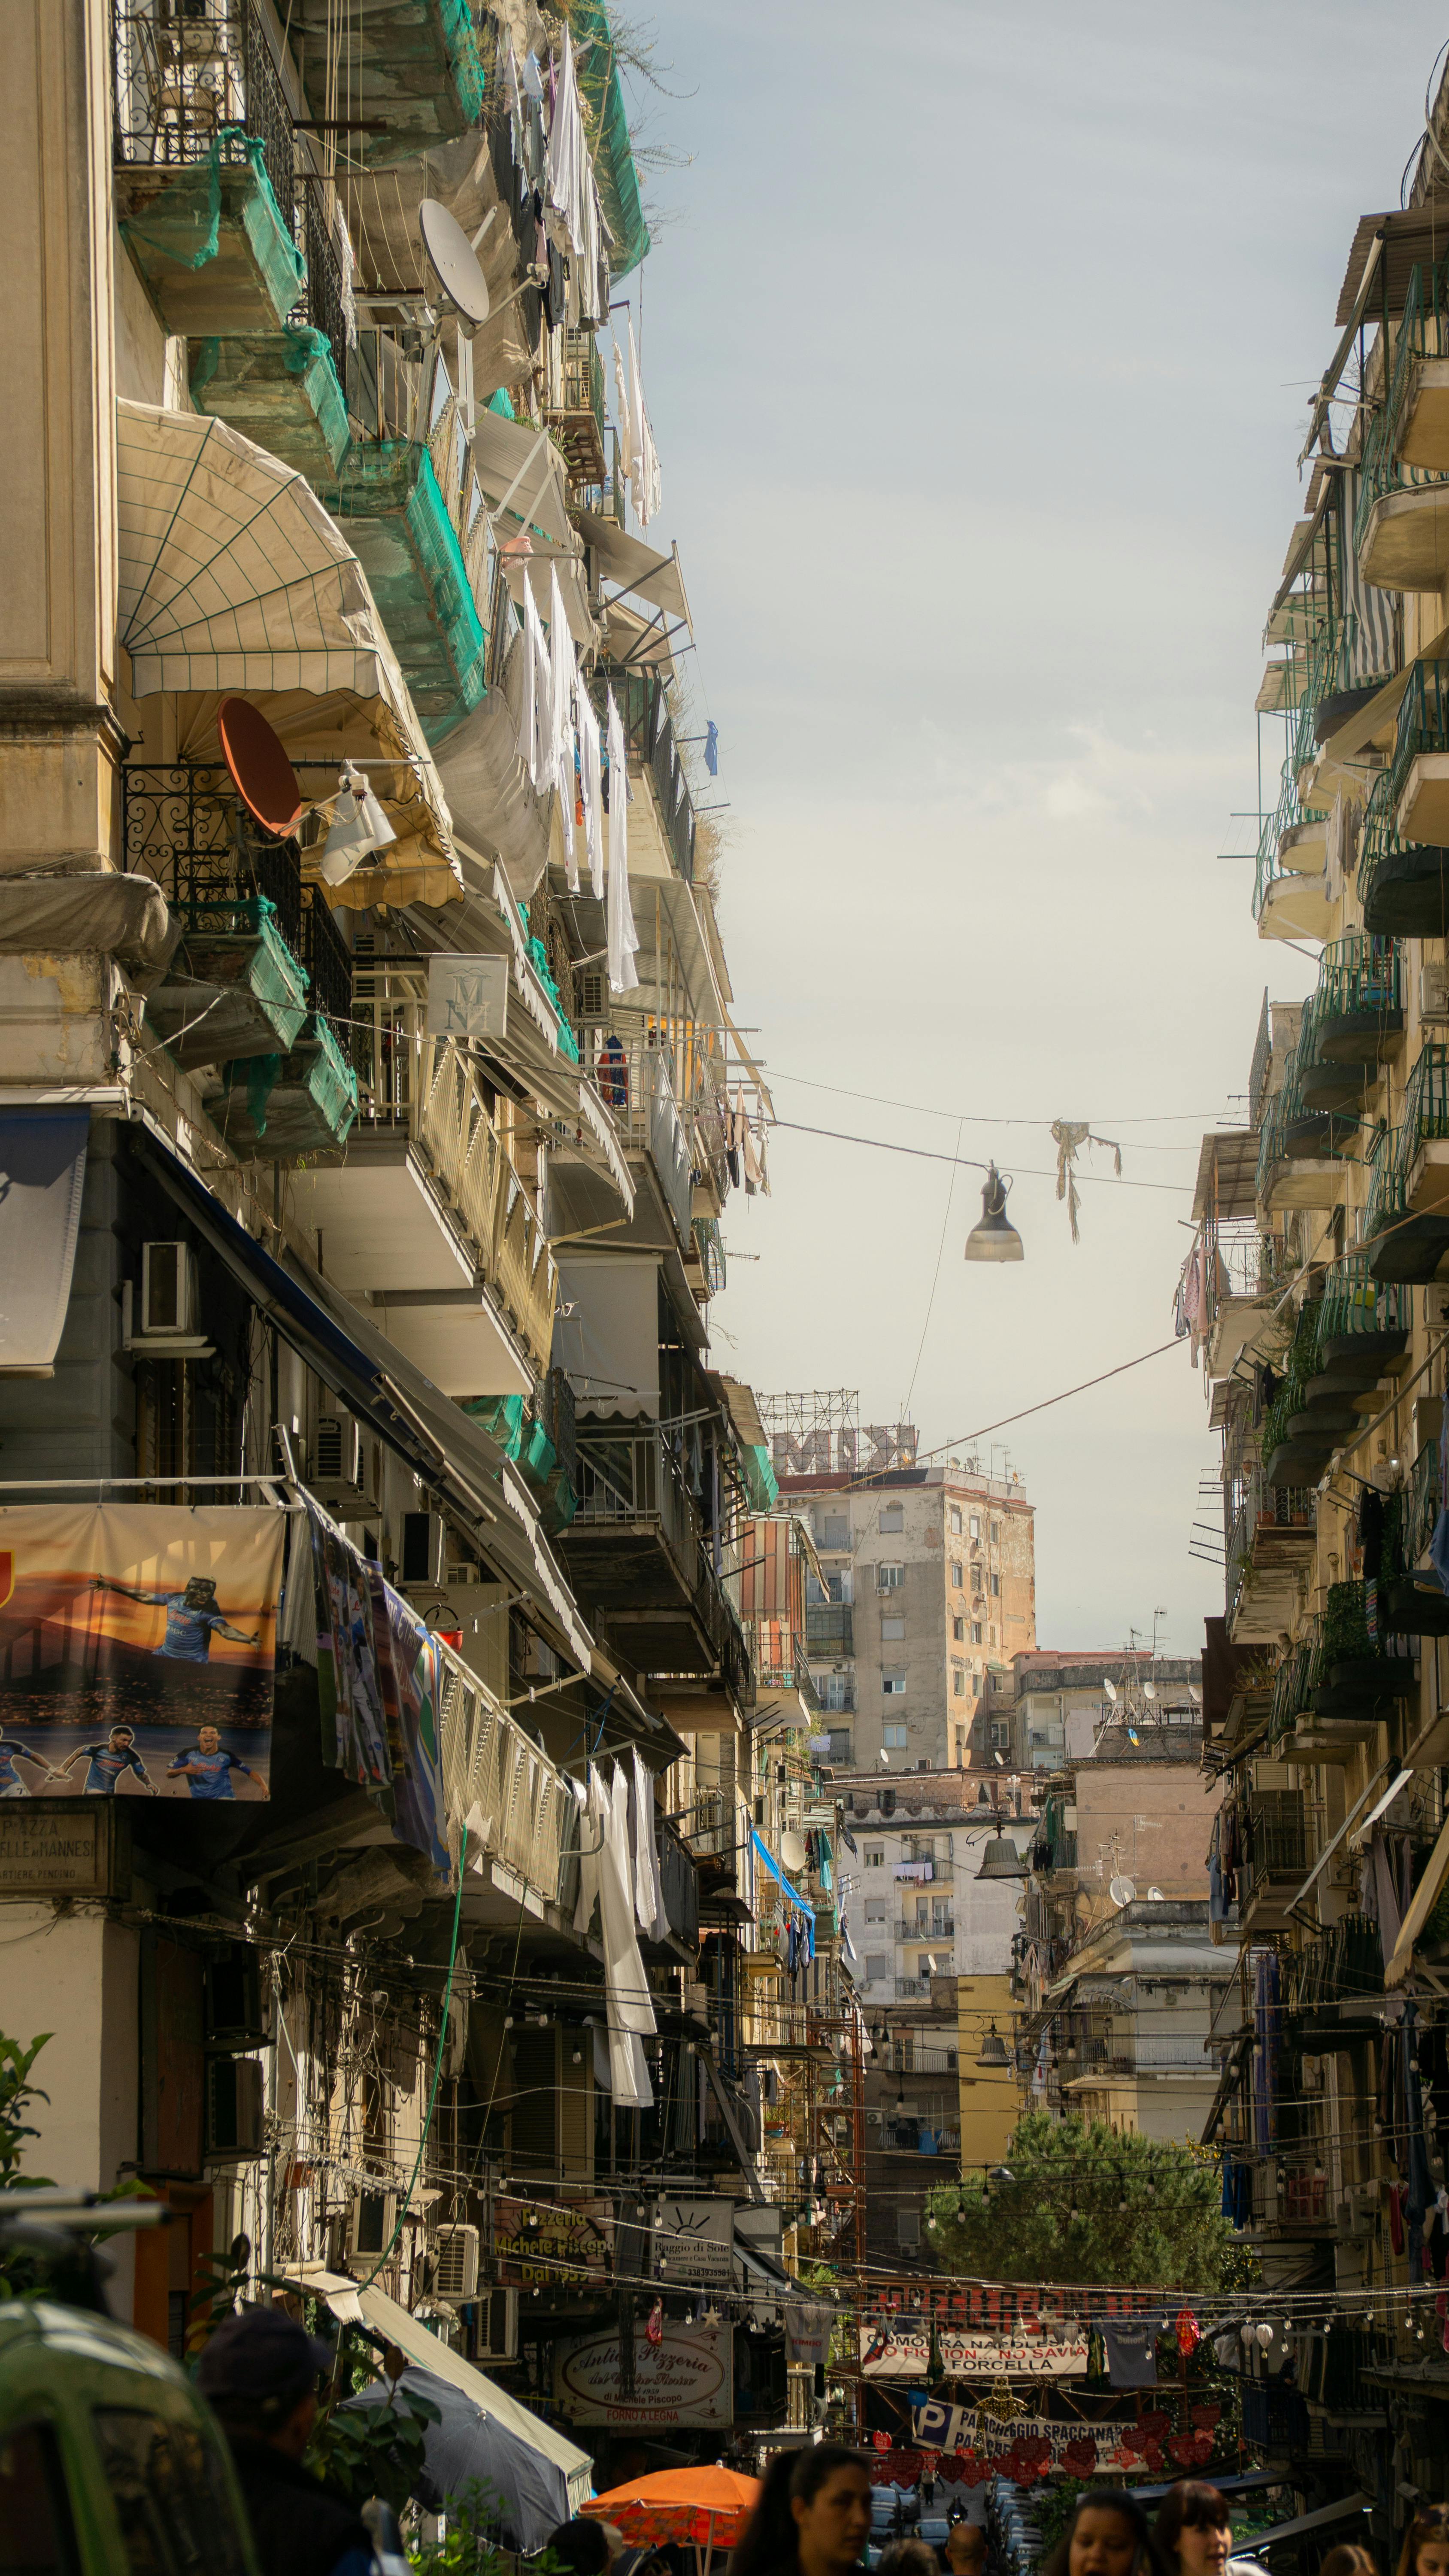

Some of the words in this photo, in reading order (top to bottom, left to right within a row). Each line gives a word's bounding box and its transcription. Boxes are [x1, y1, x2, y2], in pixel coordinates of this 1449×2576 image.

[169, 1627, 187, 1637] MSC
[3, 1819, 58, 1836] PIAZZA
[0, 1841, 30, 1857] ELLE
[38, 1869, 76, 1879] PENDINO
[521, 2208, 587, 2227] Pizzeria
[494, 2236, 553, 2256] Michele
[557, 2236, 615, 2257] Piscopo
[655, 2242, 690, 2255] Raggio
[693, 2242, 703, 2252] di
[707, 2243, 730, 2253] Sole
[521, 2264, 550, 2282] Dal
[791, 2339, 822, 2347] KIMBO
[638, 2344, 713, 2373] Pizzeria
[999, 2349, 1026, 2360] NO
[952, 2359, 1053, 2370] FORCELLA
[604, 2393, 612, 2401] di
[614, 2394, 646, 2404] Mchele
[649, 2395, 682, 2404] Piscopo
[606, 2410, 639, 2421] FORNO
[640, 2411, 646, 2421] A
[649, 2411, 679, 2421] LEGNA
[917, 2403, 946, 2437] P
